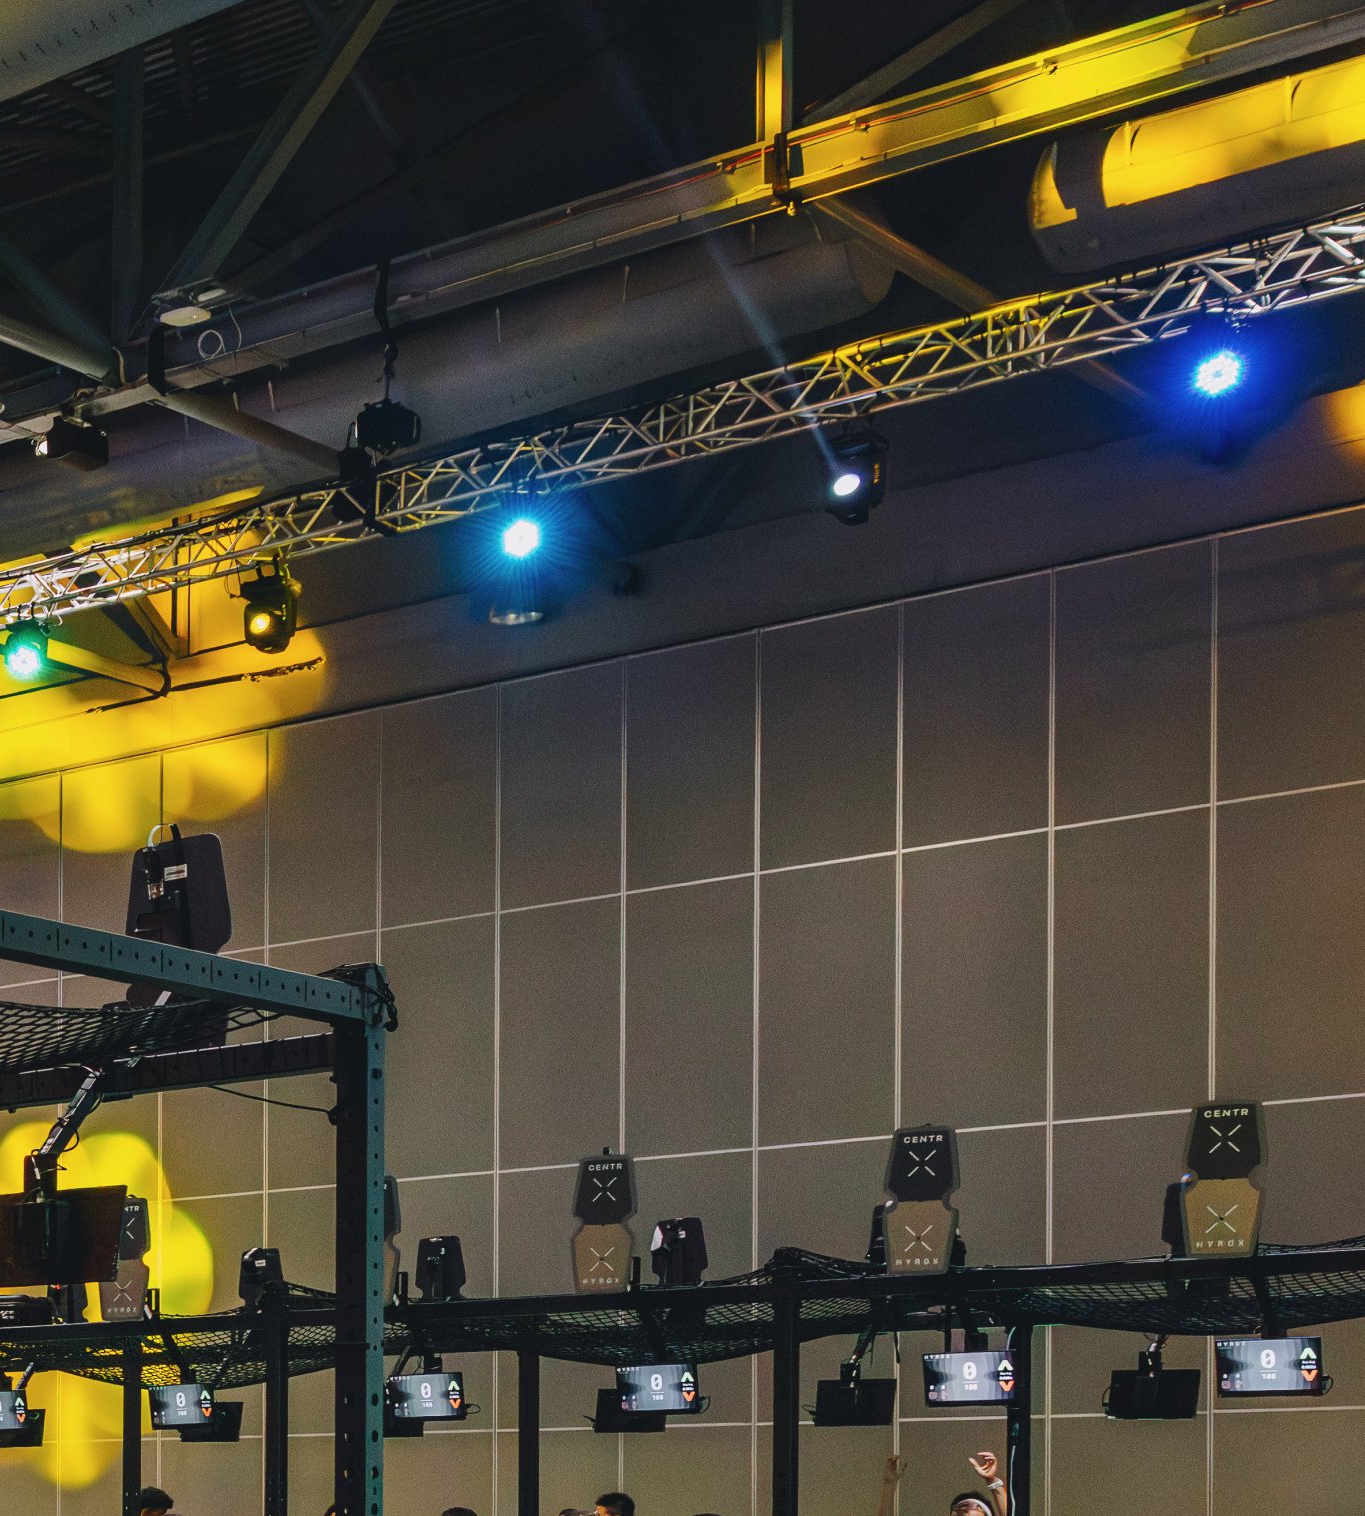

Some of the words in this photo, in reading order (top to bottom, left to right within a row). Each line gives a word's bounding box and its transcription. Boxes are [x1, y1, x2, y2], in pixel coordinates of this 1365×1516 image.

[1204, 1108, 1249, 1118] CENTR
[903, 1134, 944, 1144] CENTR
[588, 1162, 623, 1171] CENTR
[1196, 1239, 1245, 1249] HYROX
[891, 1258, 937, 1267] HYROX
[1215, 1340, 1248, 1348] HYROX
[1260, 1350, 1276, 1369] 0
[962, 1360, 978, 1380] 0
[1261, 1372, 1277, 1380] 100
[650, 1373, 663, 1391] 0
[420, 1381, 432, 1399] 0
[175, 1391, 186, 1406] 0
